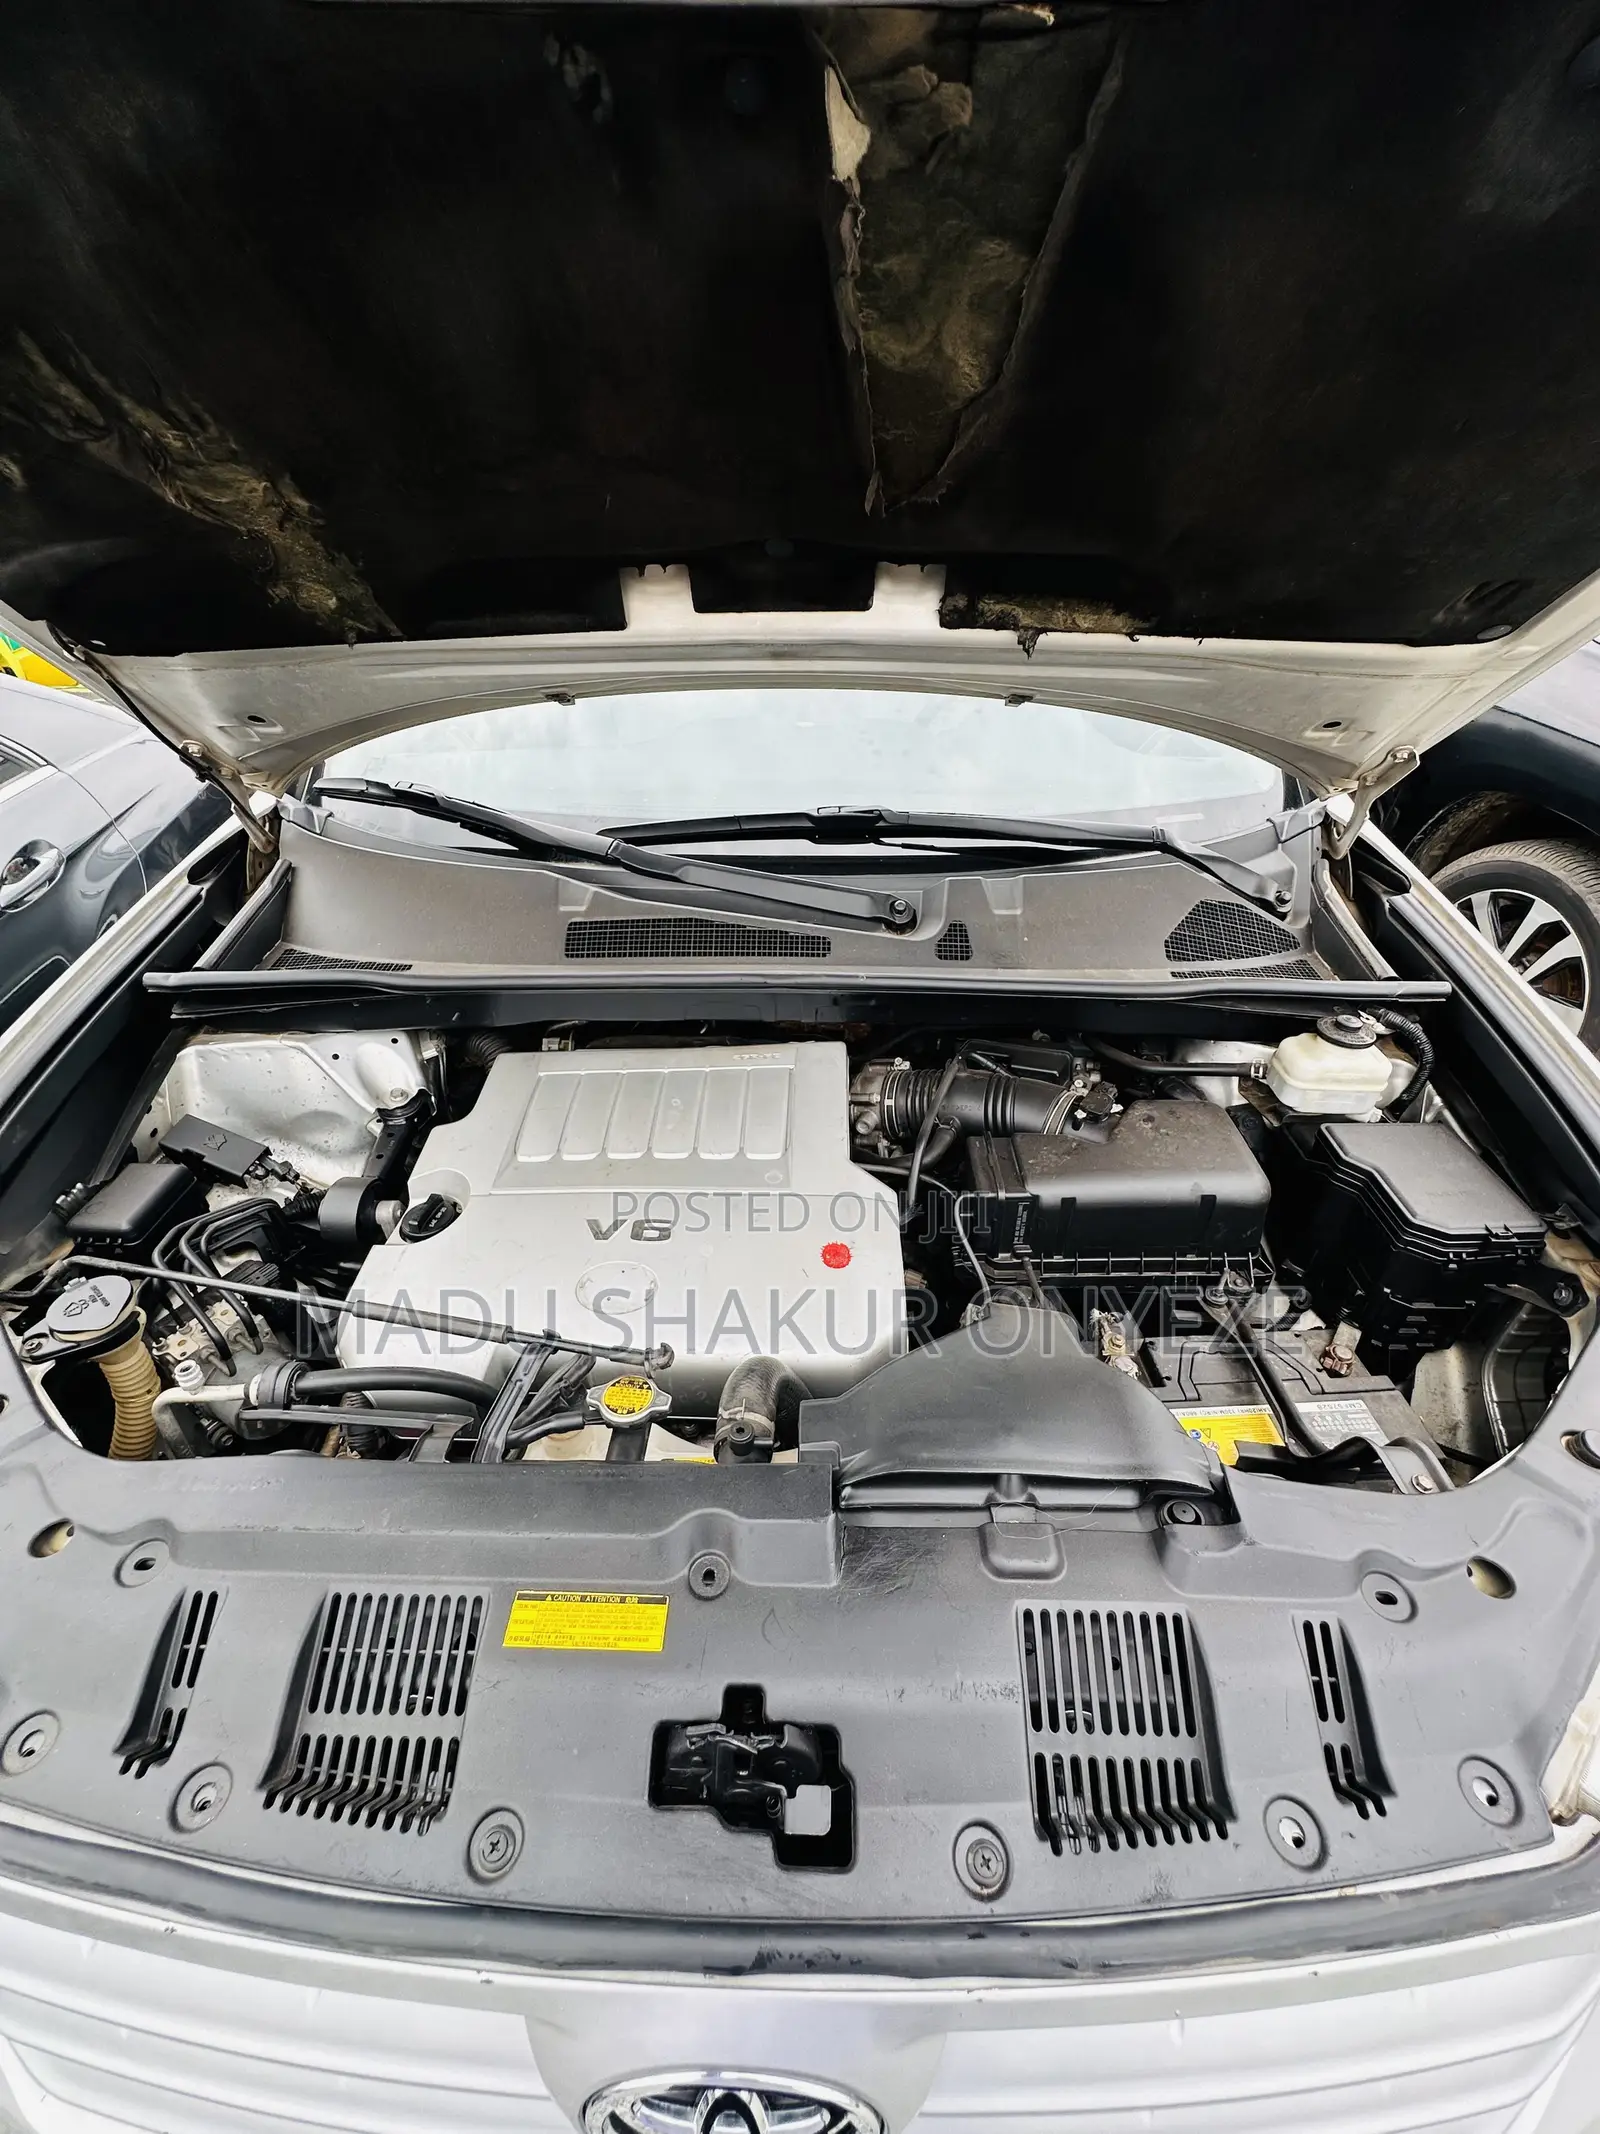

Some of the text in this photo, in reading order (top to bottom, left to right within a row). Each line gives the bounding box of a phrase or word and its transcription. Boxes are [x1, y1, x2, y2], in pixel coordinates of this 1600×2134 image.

[586, 1218, 674, 1242] V6
[553, 1594, 621, 1604] CAUTION ATTENTION
